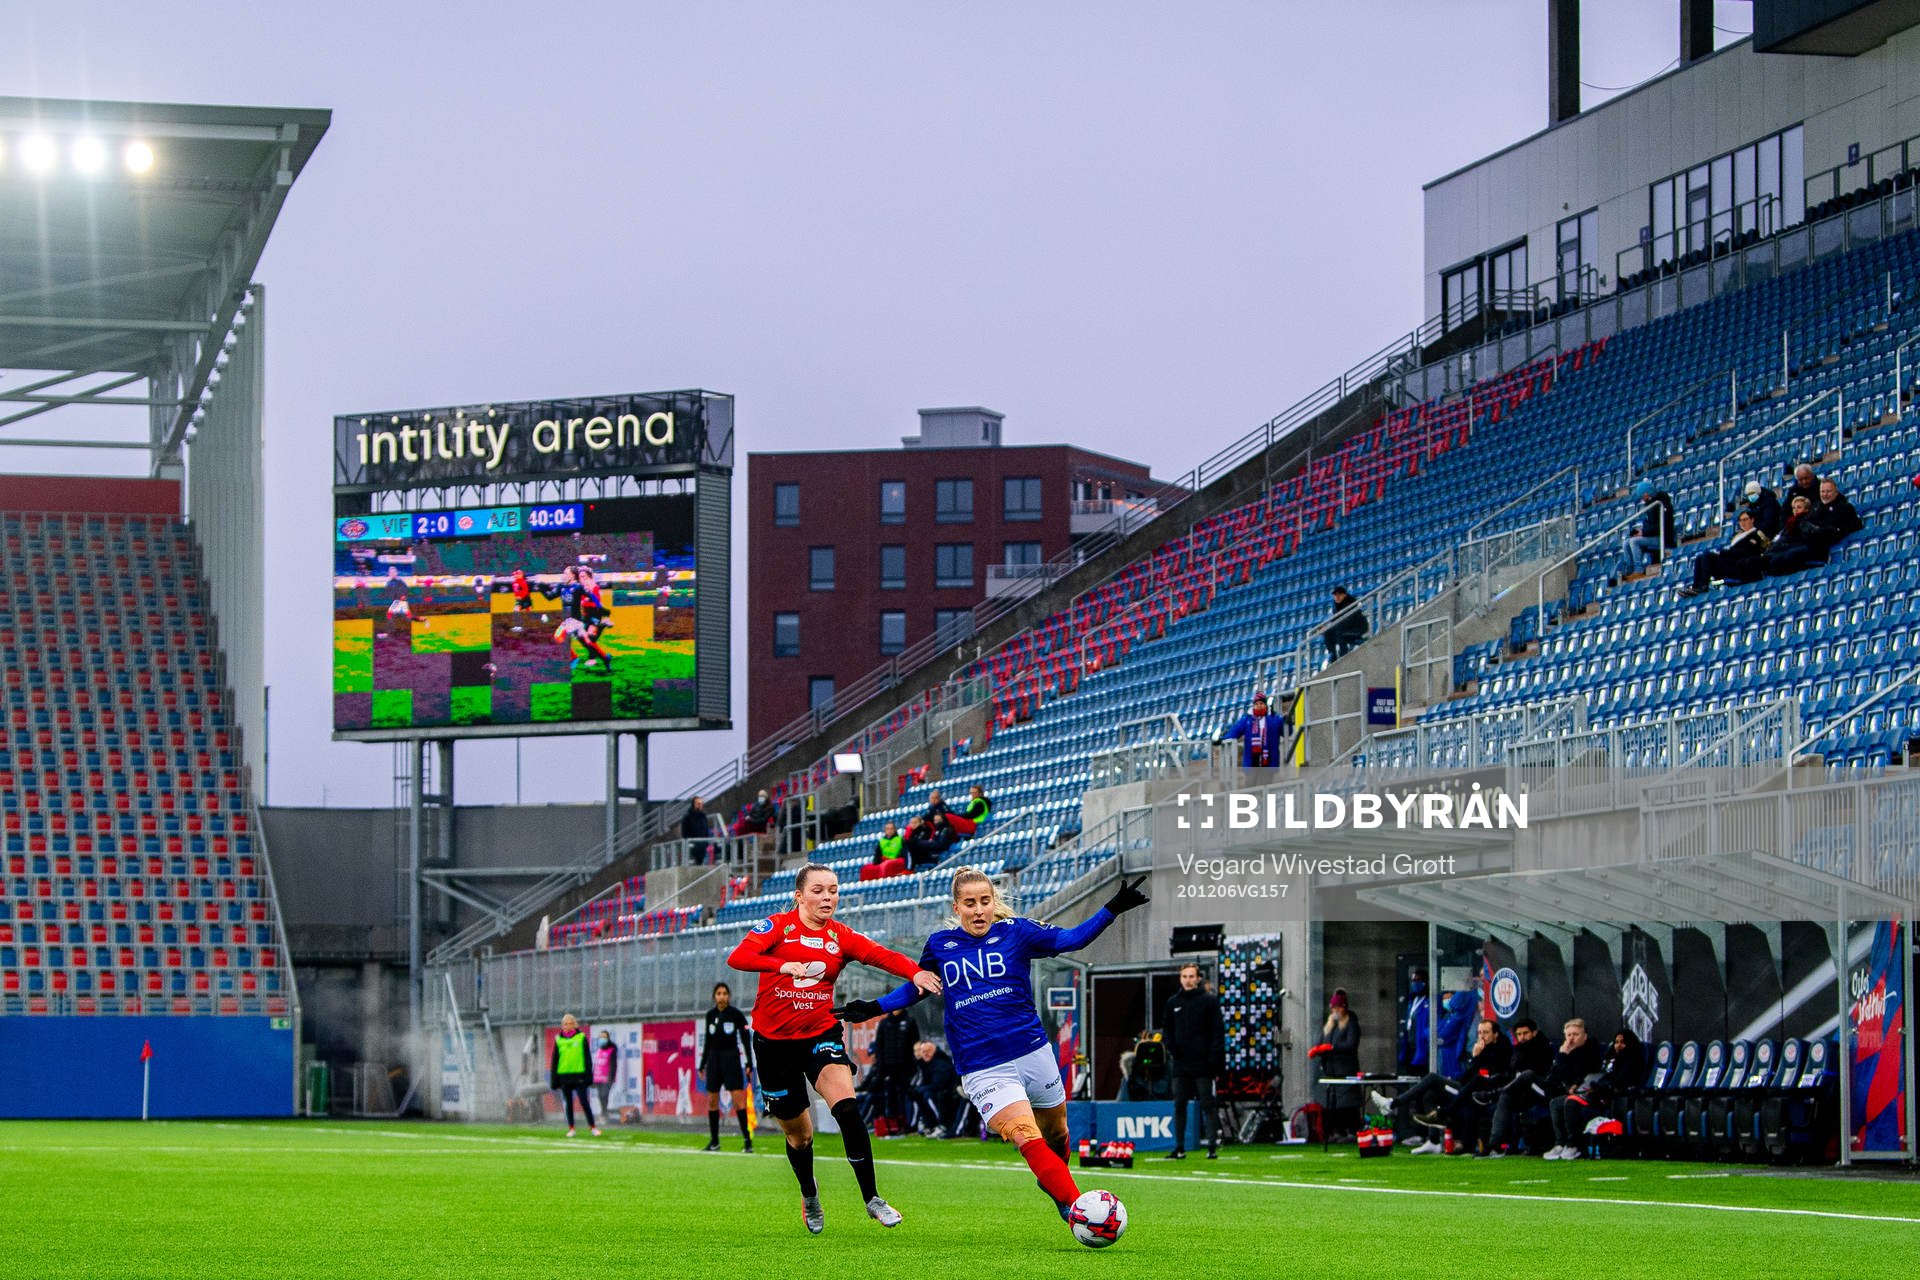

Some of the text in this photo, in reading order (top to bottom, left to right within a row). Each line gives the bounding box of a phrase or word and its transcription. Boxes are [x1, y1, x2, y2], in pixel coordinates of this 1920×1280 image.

[357, 409, 676, 469] intility arena
[381, 516, 410, 535] VIF
[417, 515, 448, 534] 2:0
[528, 508, 576, 526] 40:04
[943, 948, 1007, 990] DNB
[774, 987, 831, 1000] Sparebanken
[793, 1001, 814, 1010] Vest
[1116, 1115, 1174, 1138] NRK
